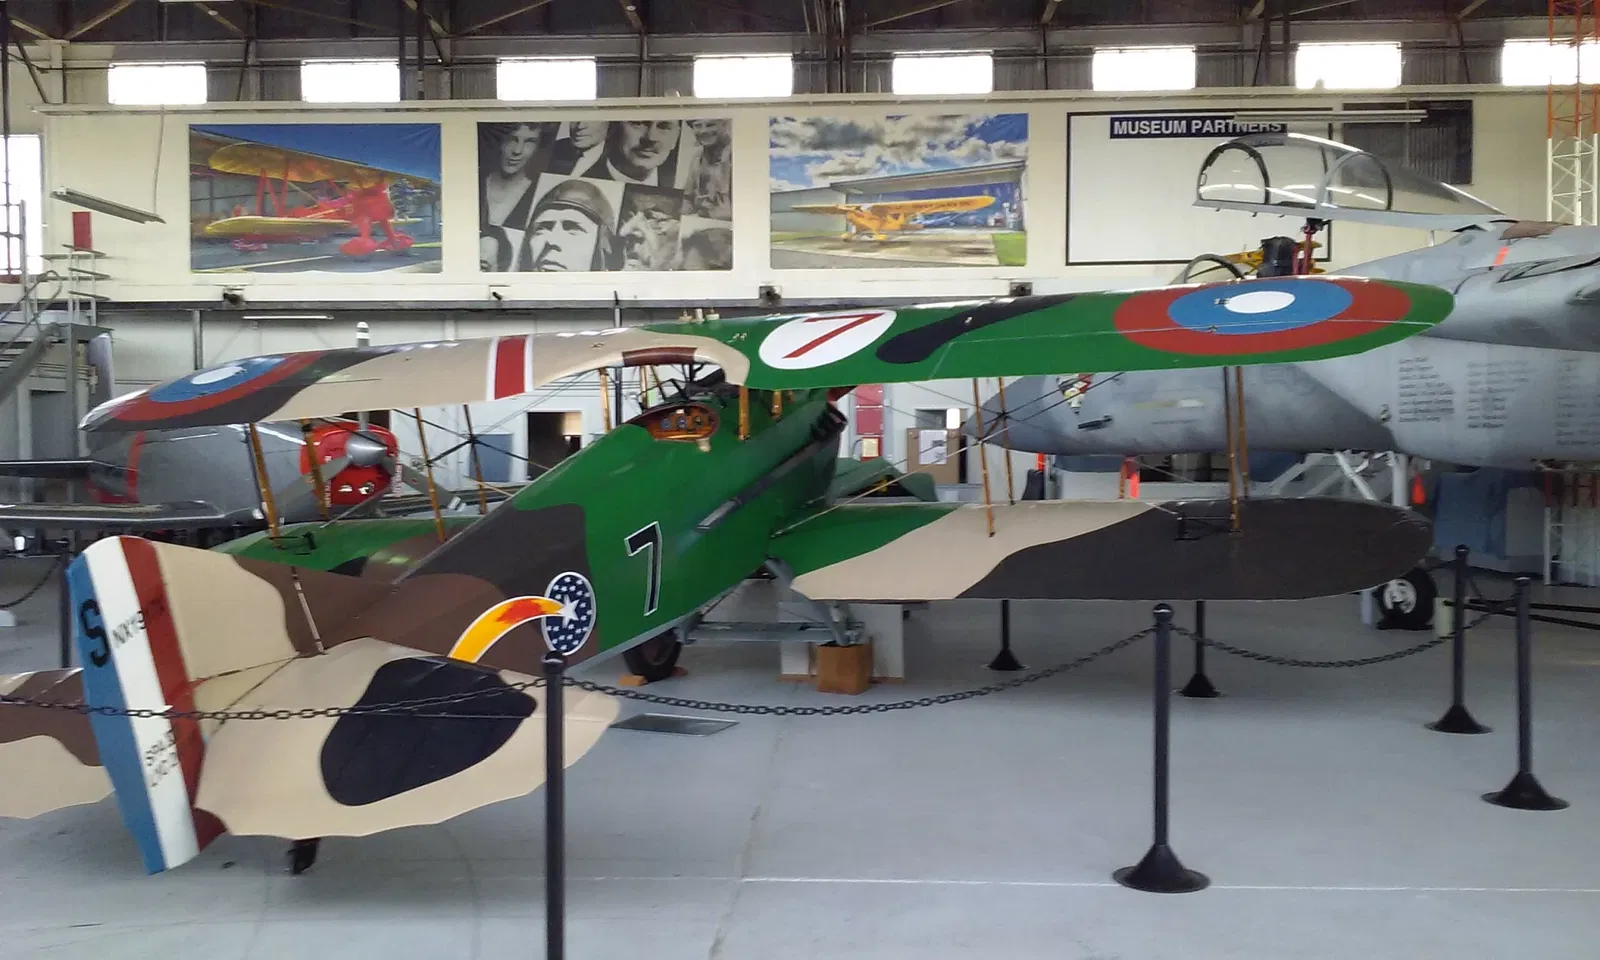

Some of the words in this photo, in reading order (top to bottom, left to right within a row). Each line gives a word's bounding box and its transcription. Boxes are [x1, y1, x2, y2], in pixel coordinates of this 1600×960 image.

[1113, 120, 1187, 135] MUSEUM
[1191, 119, 1282, 134] PARTNERS
[781, 312, 885, 359] 7
[623, 521, 663, 617] 7
[80, 598, 112, 668] S
